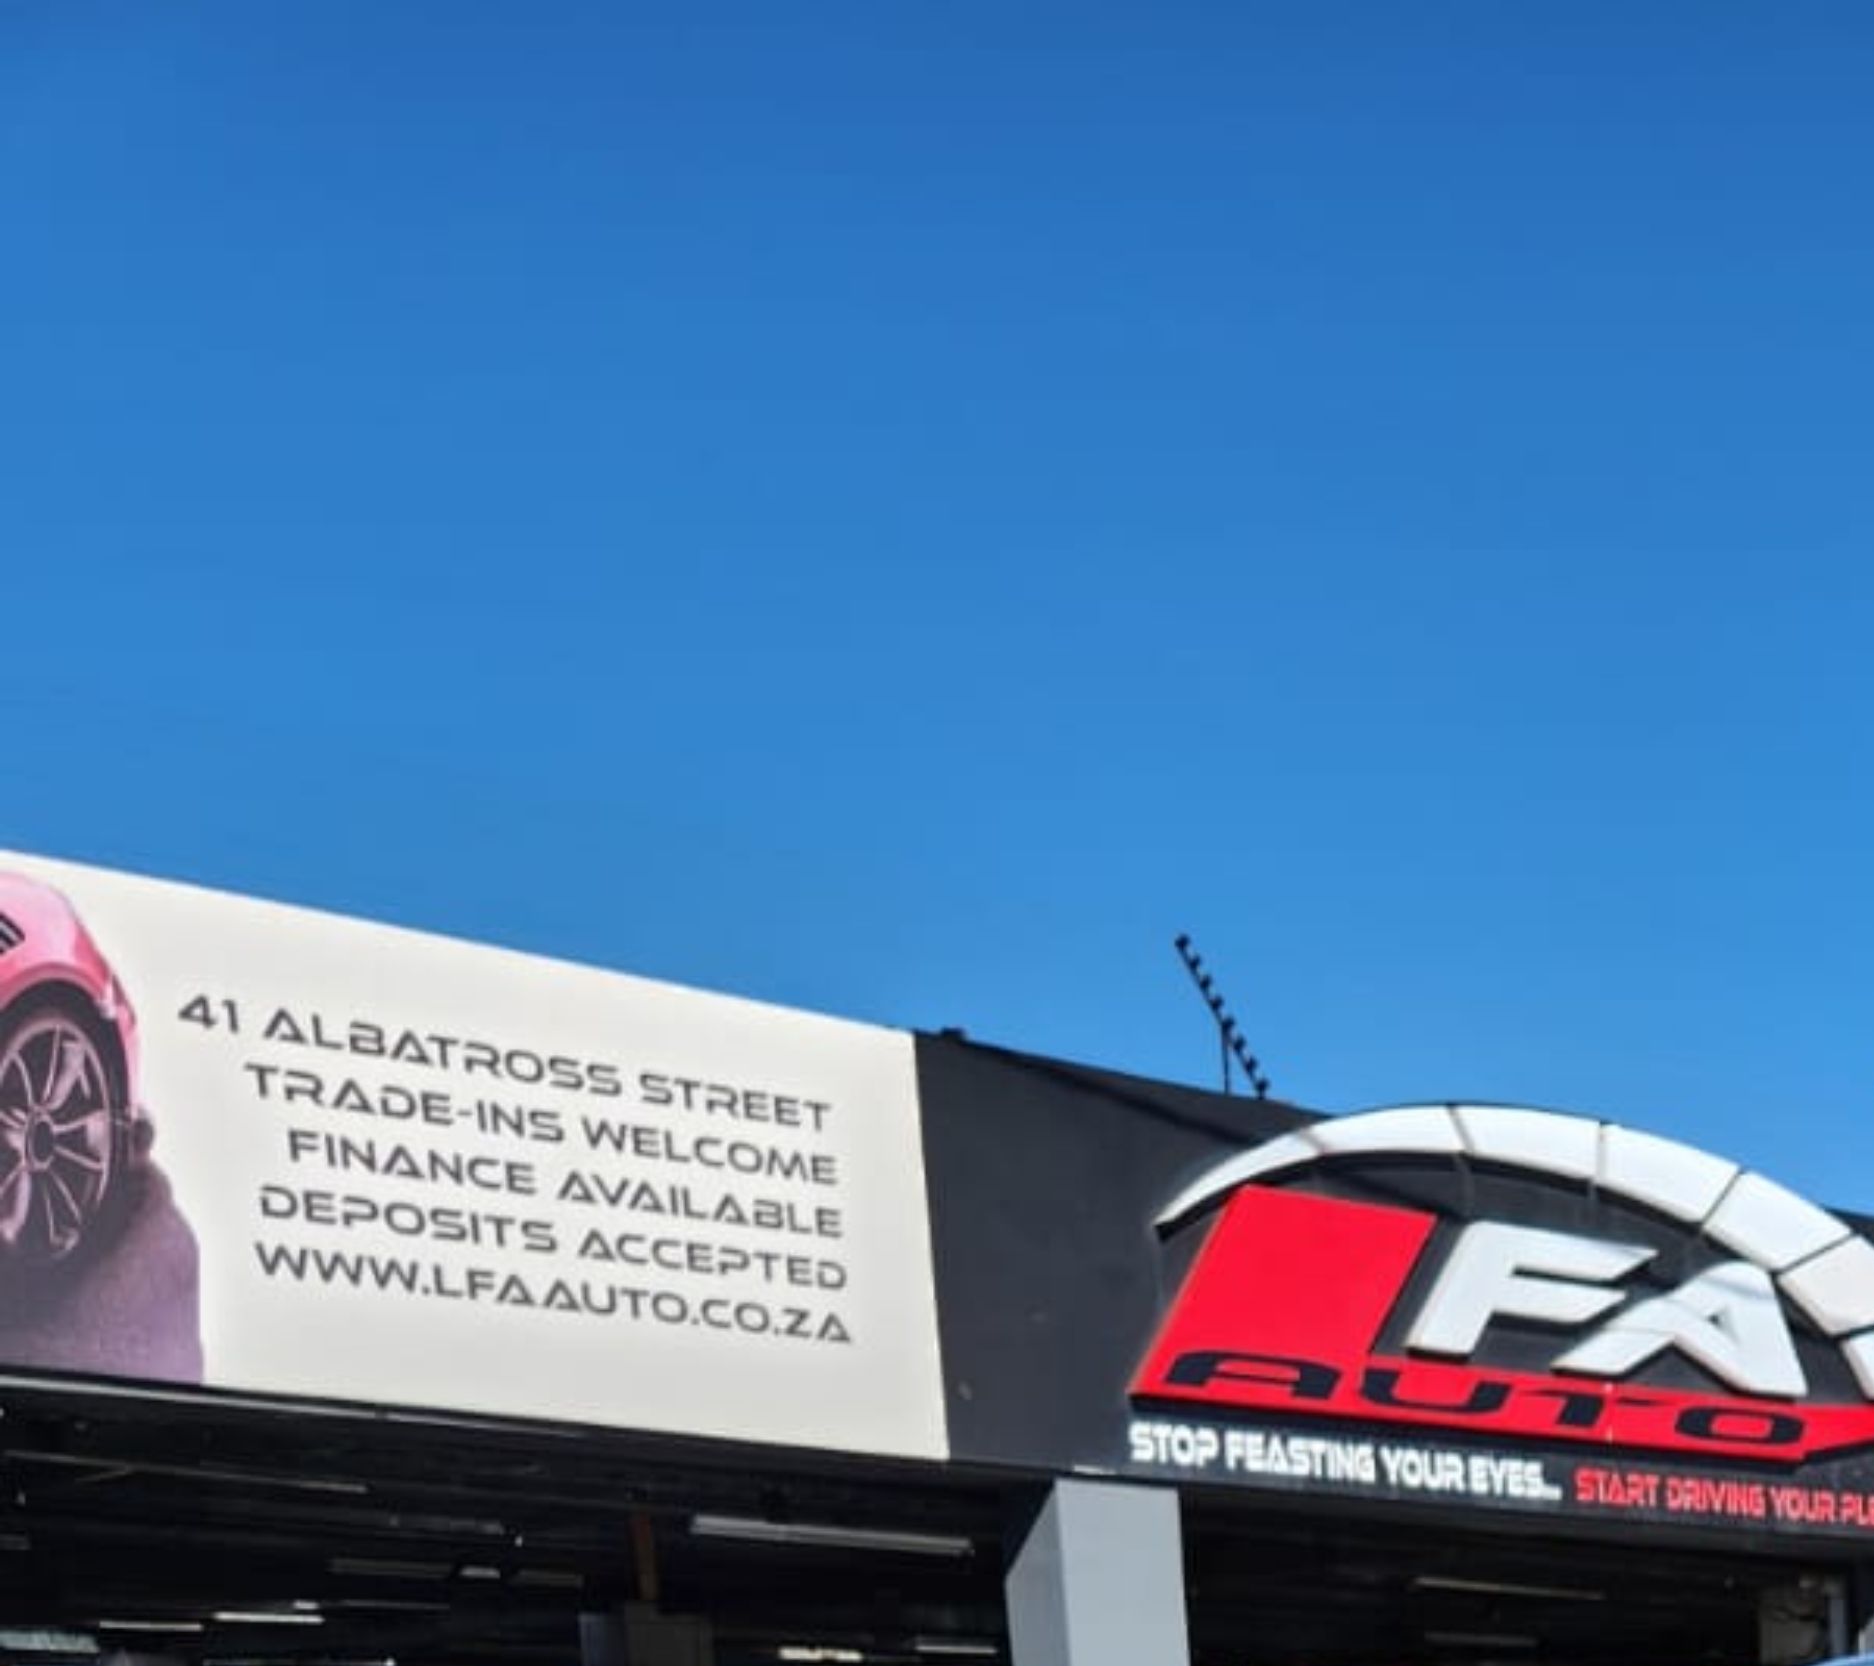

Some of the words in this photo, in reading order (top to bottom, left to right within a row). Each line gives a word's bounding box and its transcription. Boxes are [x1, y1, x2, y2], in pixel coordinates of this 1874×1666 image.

[177, 993, 240, 1036] 41
[261, 1006, 624, 1097] ALBATROSS
[639, 1070, 833, 1135] STREET
[245, 1062, 566, 1147] TRADE-INS
[580, 1116, 840, 1188] WELCOME
[288, 1128, 539, 1197] FINANCE
[556, 1169, 844, 1241] AVAILABLE
[259, 1184, 559, 1256] DEPOSITS
[577, 1228, 849, 1293] ACCEPTED
[255, 1241, 853, 1345] WWW.LFAAUTO.CO.ZA
[1163, 1349, 1810, 1448] AUTO
[1127, 1420, 1220, 1469] STOP
[1223, 1428, 1376, 1484] FEASTING
[1380, 1447, 1467, 1493] YOUR
[1574, 1466, 1659, 1508] START
[1665, 1477, 1766, 1518] DRIVING
[1769, 1485, 1836, 1522] YOUR
